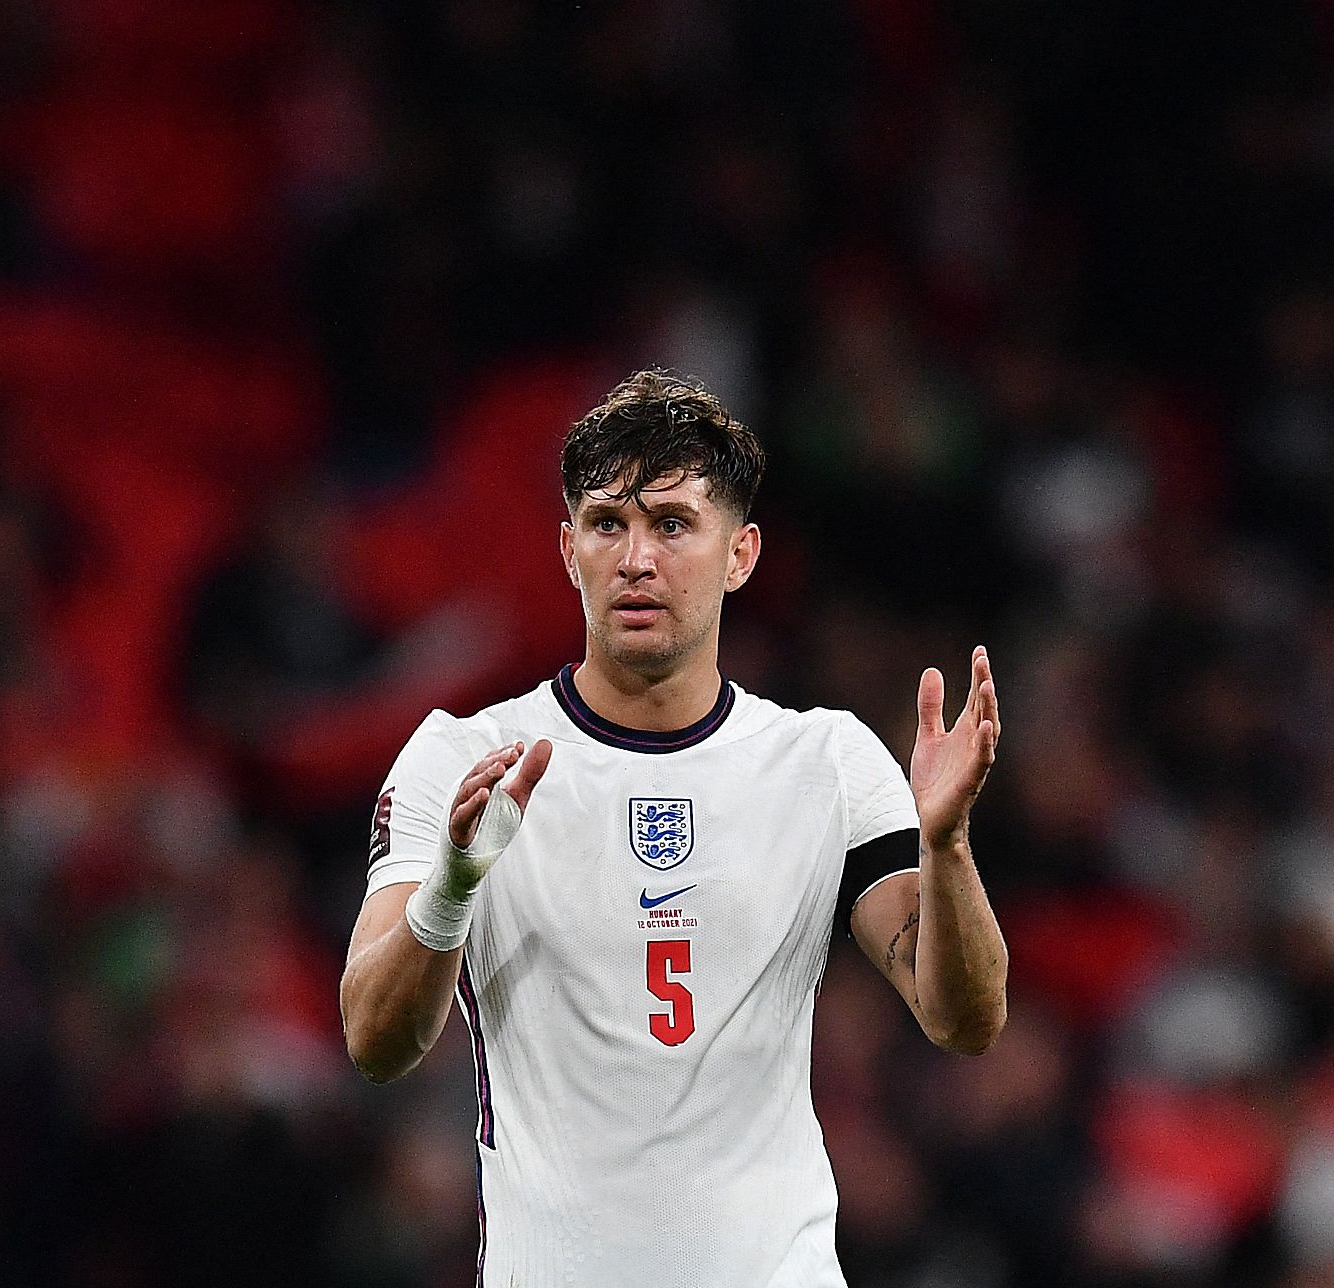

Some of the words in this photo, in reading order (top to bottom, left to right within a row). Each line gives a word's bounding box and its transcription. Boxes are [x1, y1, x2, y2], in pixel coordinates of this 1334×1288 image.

[649, 909, 682, 918] HUNGARY
[637, 920, 645, 929] 12
[647, 919, 680, 928] OCTOBER
[682, 918, 698, 927] 2021
[646, 939, 696, 1047] 5
